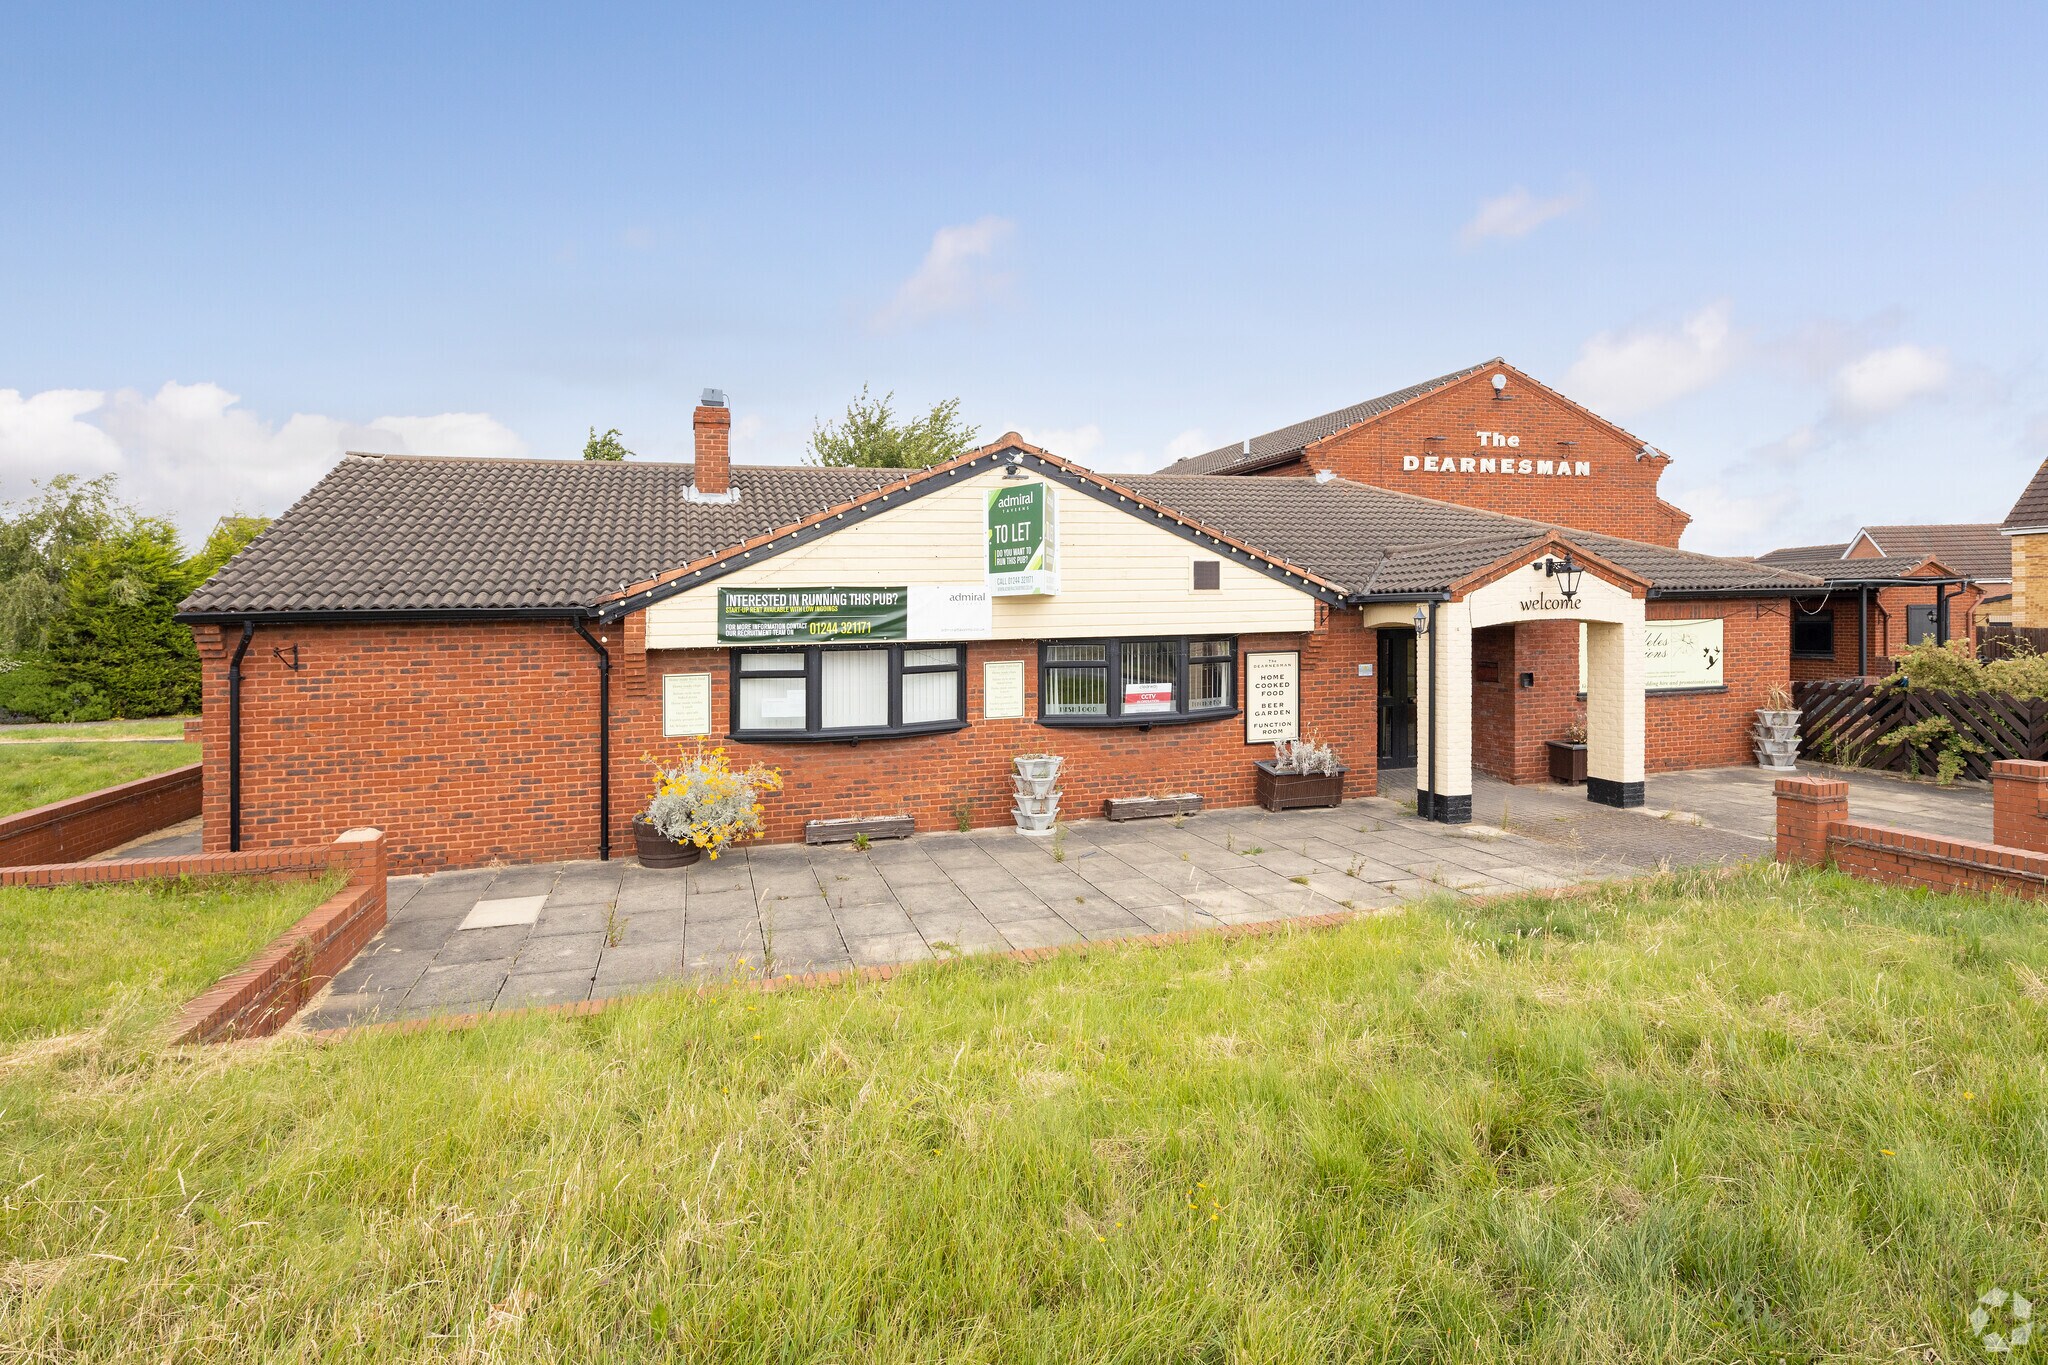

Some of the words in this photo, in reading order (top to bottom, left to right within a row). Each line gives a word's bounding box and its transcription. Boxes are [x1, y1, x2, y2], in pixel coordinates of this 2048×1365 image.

[1476, 431, 1520, 447] The
[1403, 455, 1591, 477] DEARNESMAN
[998, 491, 1034, 508] admiral
[994, 524, 1008, 544] TO
[1011, 521, 1031, 543] LET
[996, 549, 1003, 558] DO
[1003, 548, 1013, 557] YOU
[1013, 547, 1025, 556] WANT
[1026, 546, 1032, 555] TO
[996, 557, 1006, 566] RUN
[1007, 556, 1017, 566] THIS
[1017, 556, 1028, 565] PUB?
[726, 594, 787, 607] INTERESTED
[789, 594, 799, 606] IN
[801, 593, 847, 606] RUNNING
[849, 593, 871, 606] THIS
[872, 592, 898, 606] PUB?
[949, 592, 986, 602] admiral
[1520, 591, 1582, 611] welcome
[736, 623, 752, 631] MORE
[786, 622, 808, 630] CONTACT
[809, 622, 838, 635] 01244
[840, 621, 871, 634] 321171
[1255, 681, 1290, 689] COOKED
[1254, 709, 1291, 717] GARDEN
[1253, 721, 1292, 729] FUNCTION
